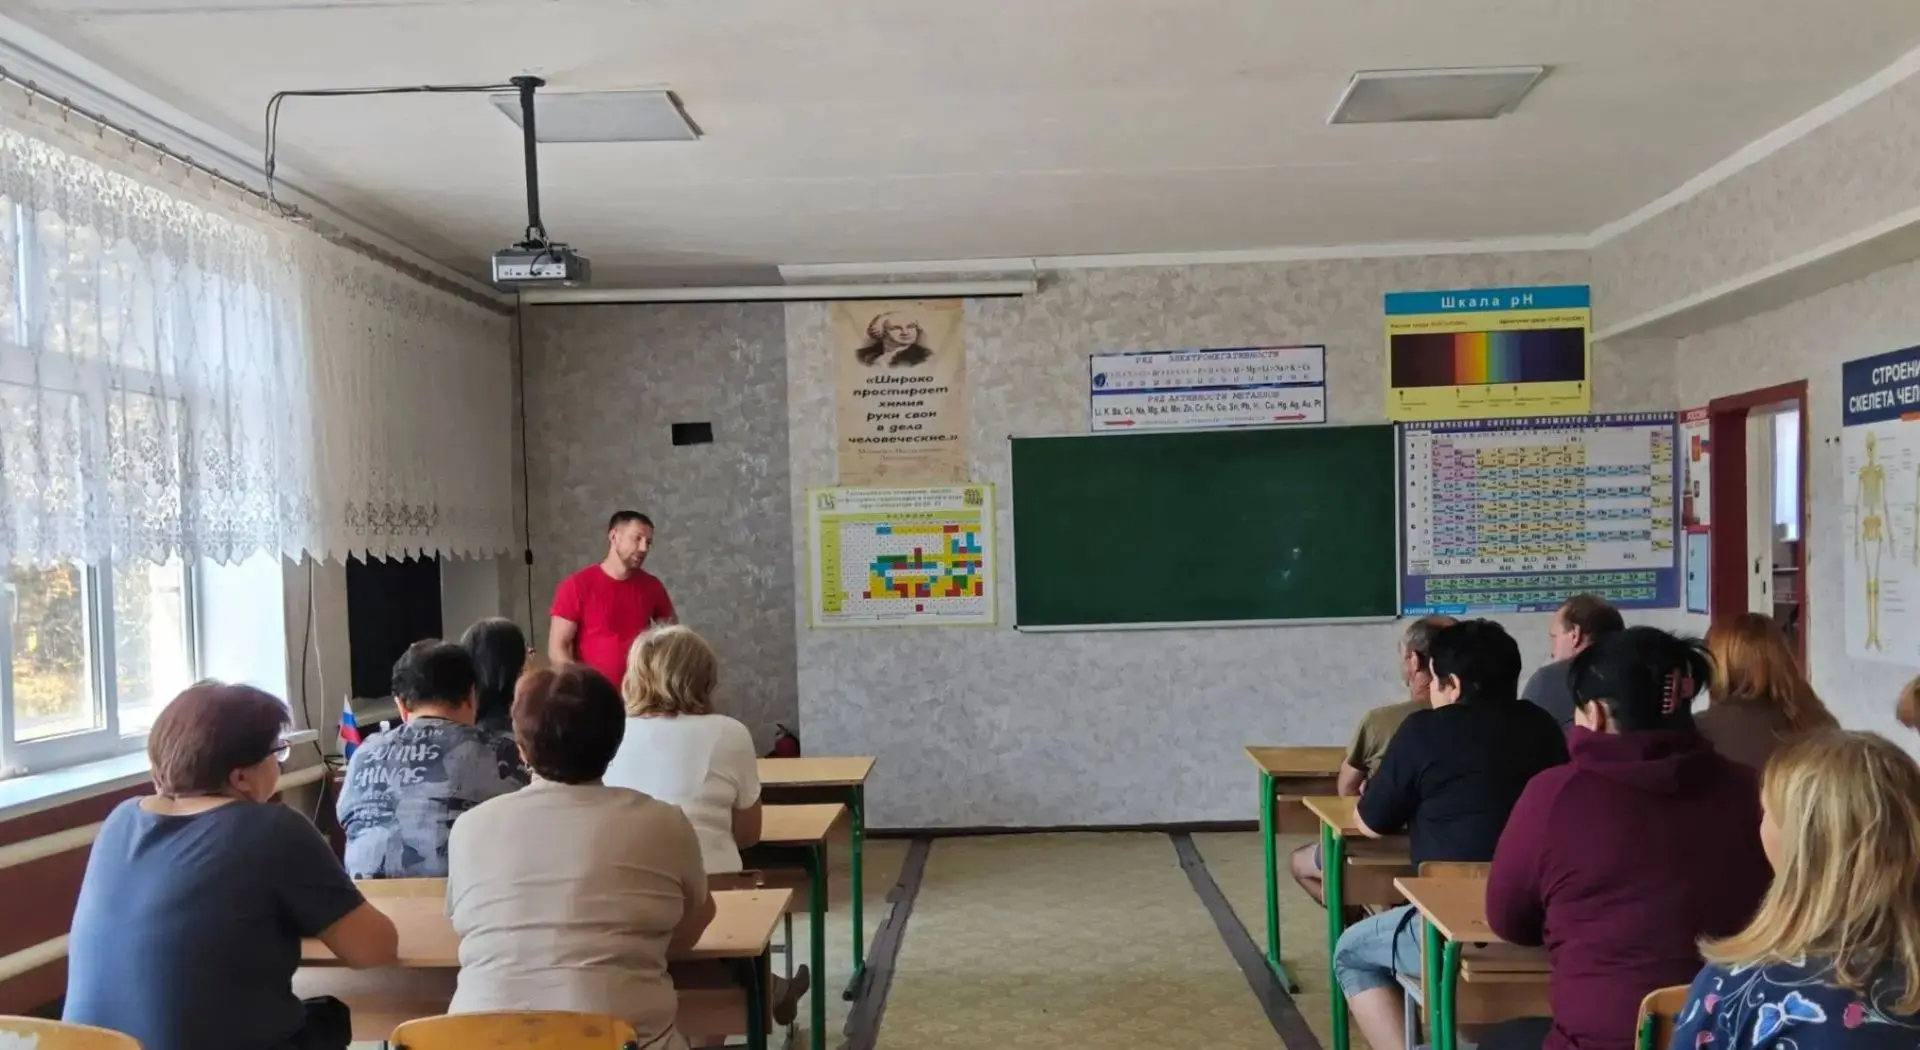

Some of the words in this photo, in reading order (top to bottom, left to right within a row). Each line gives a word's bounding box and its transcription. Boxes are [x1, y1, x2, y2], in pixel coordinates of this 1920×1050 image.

[1441, 296, 1500, 309] Шкала
[1511, 293, 1533, 308] pH
[866, 375, 934, 386] «Широко
[853, 387, 948, 398] простирает
[1849, 390, 1895, 413] СКЕЛЕТА
[867, 412, 900, 421] руки
[905, 411, 937, 419] свои
[889, 424, 922, 433] дела
